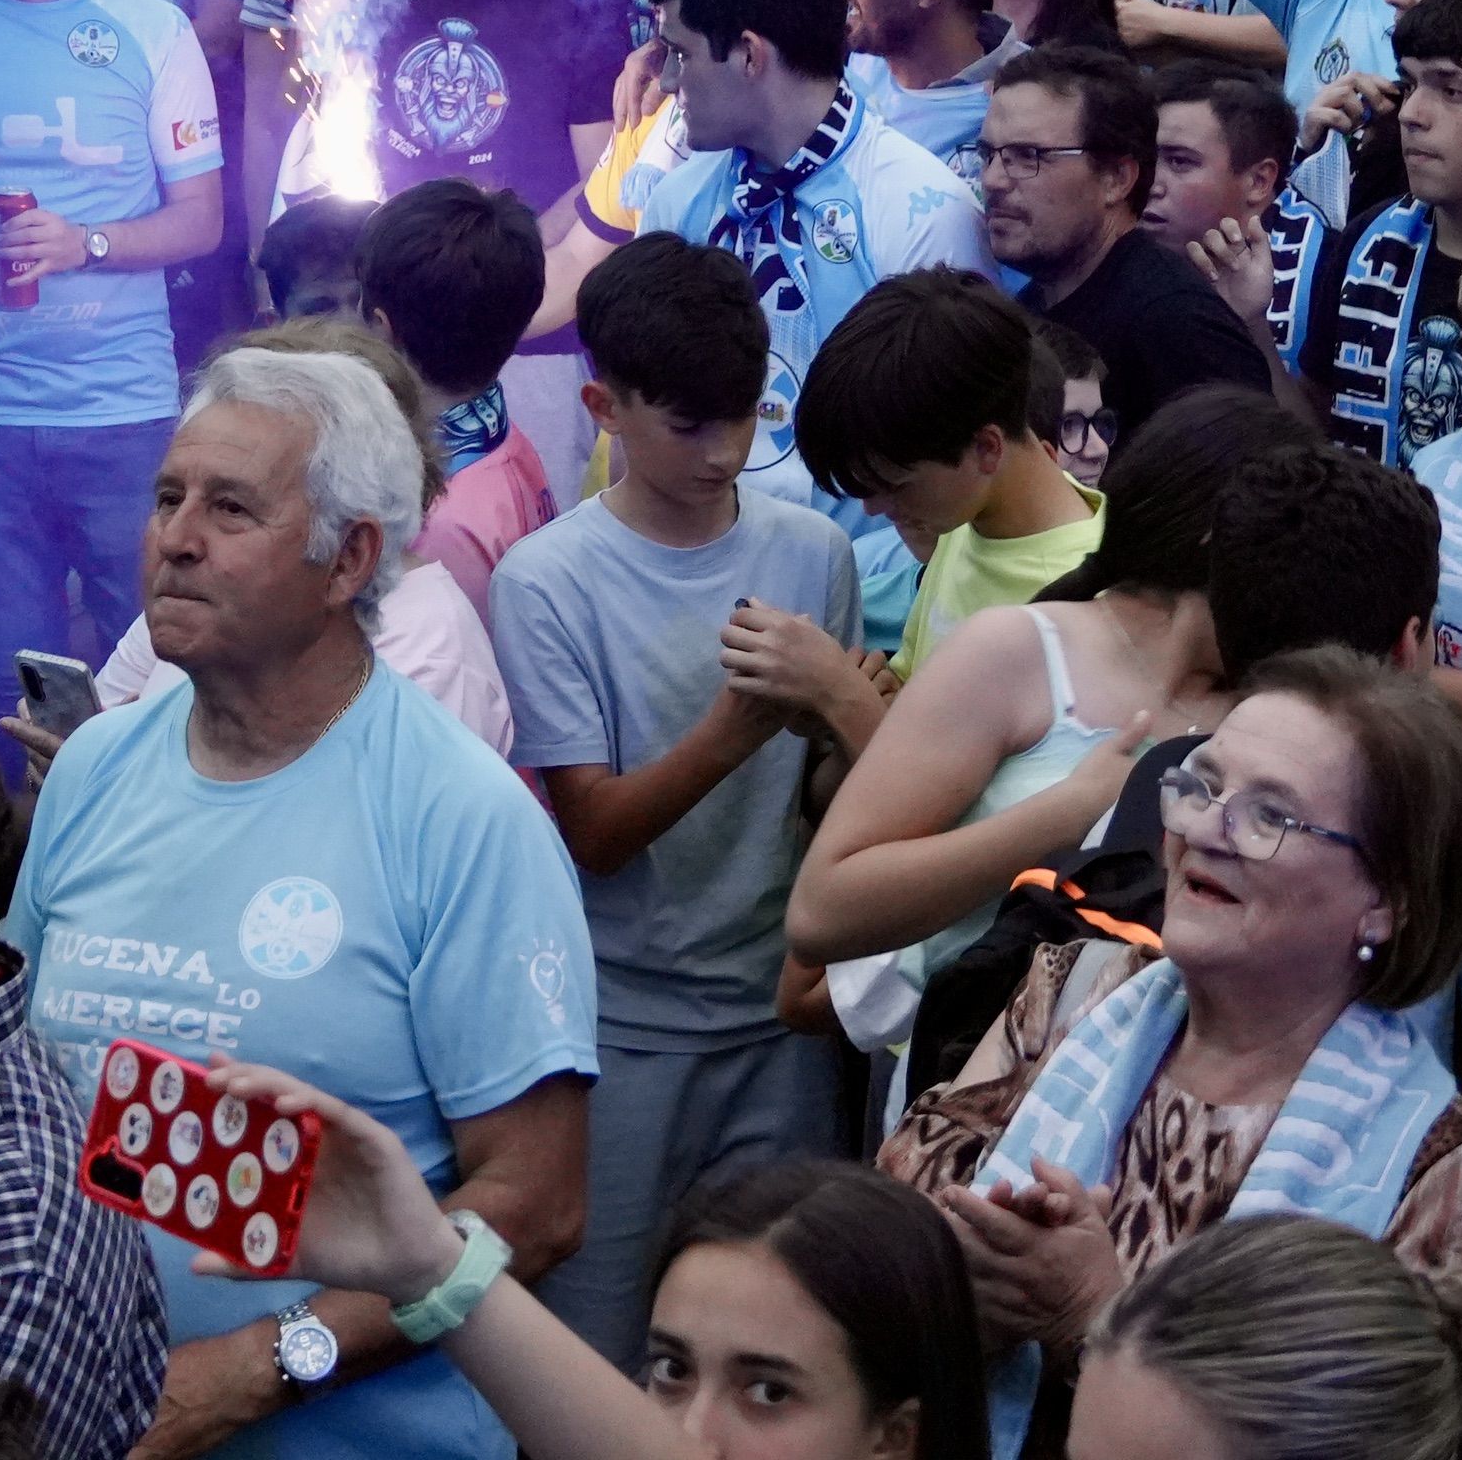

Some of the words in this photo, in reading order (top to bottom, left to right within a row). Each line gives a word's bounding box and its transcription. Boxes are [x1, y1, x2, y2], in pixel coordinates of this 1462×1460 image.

[49, 930, 214, 984] LUCENA
[42, 987, 242, 1049] MERECE
[215, 983, 261, 1009] LO
